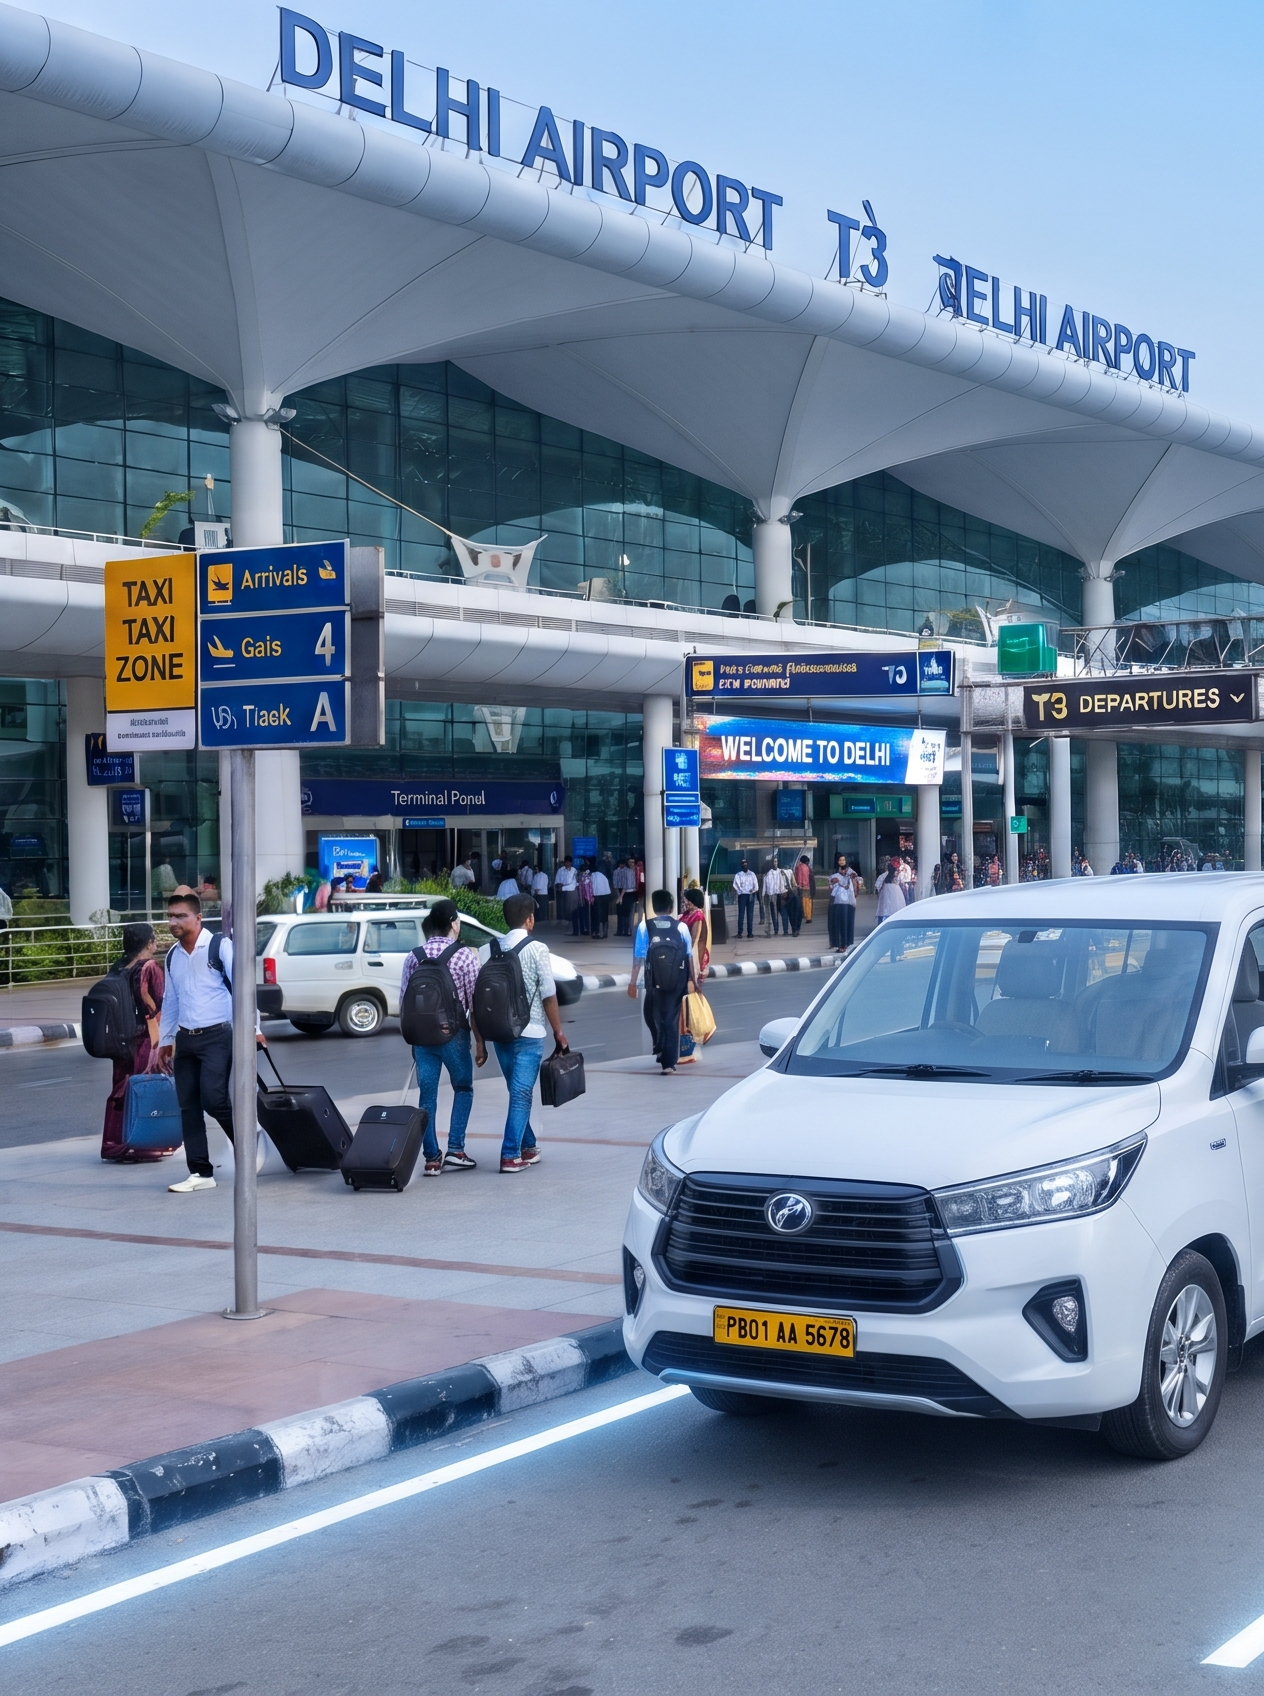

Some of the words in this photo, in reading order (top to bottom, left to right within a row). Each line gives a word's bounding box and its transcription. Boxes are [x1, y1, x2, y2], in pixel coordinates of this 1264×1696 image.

[276, 5, 500, 157] DELHI
[521, 106, 783, 251] AIRPORT
[1056, 303, 1196, 393] AIRPORT
[122, 577, 174, 608] TAXI
[241, 564, 308, 590] Arrivals
[122, 615, 175, 646] TAXI
[241, 635, 282, 658] Gais
[314, 622, 336, 667] 4
[116, 652, 184, 683] ZONE
[309, 691, 337, 732] A
[1031, 692, 1068, 721] T3
[1079, 688, 1220, 713] DEPARTURES
[721, 735, 813, 763] WELCOME
[816, 740, 840, 764] TO
[843, 742, 890, 766] DELHI
[391, 790, 448, 805] Terminal
[726, 1315, 769, 1342] PB01
[776, 1321, 798, 1344] AA
[805, 1323, 850, 1349] 5678
